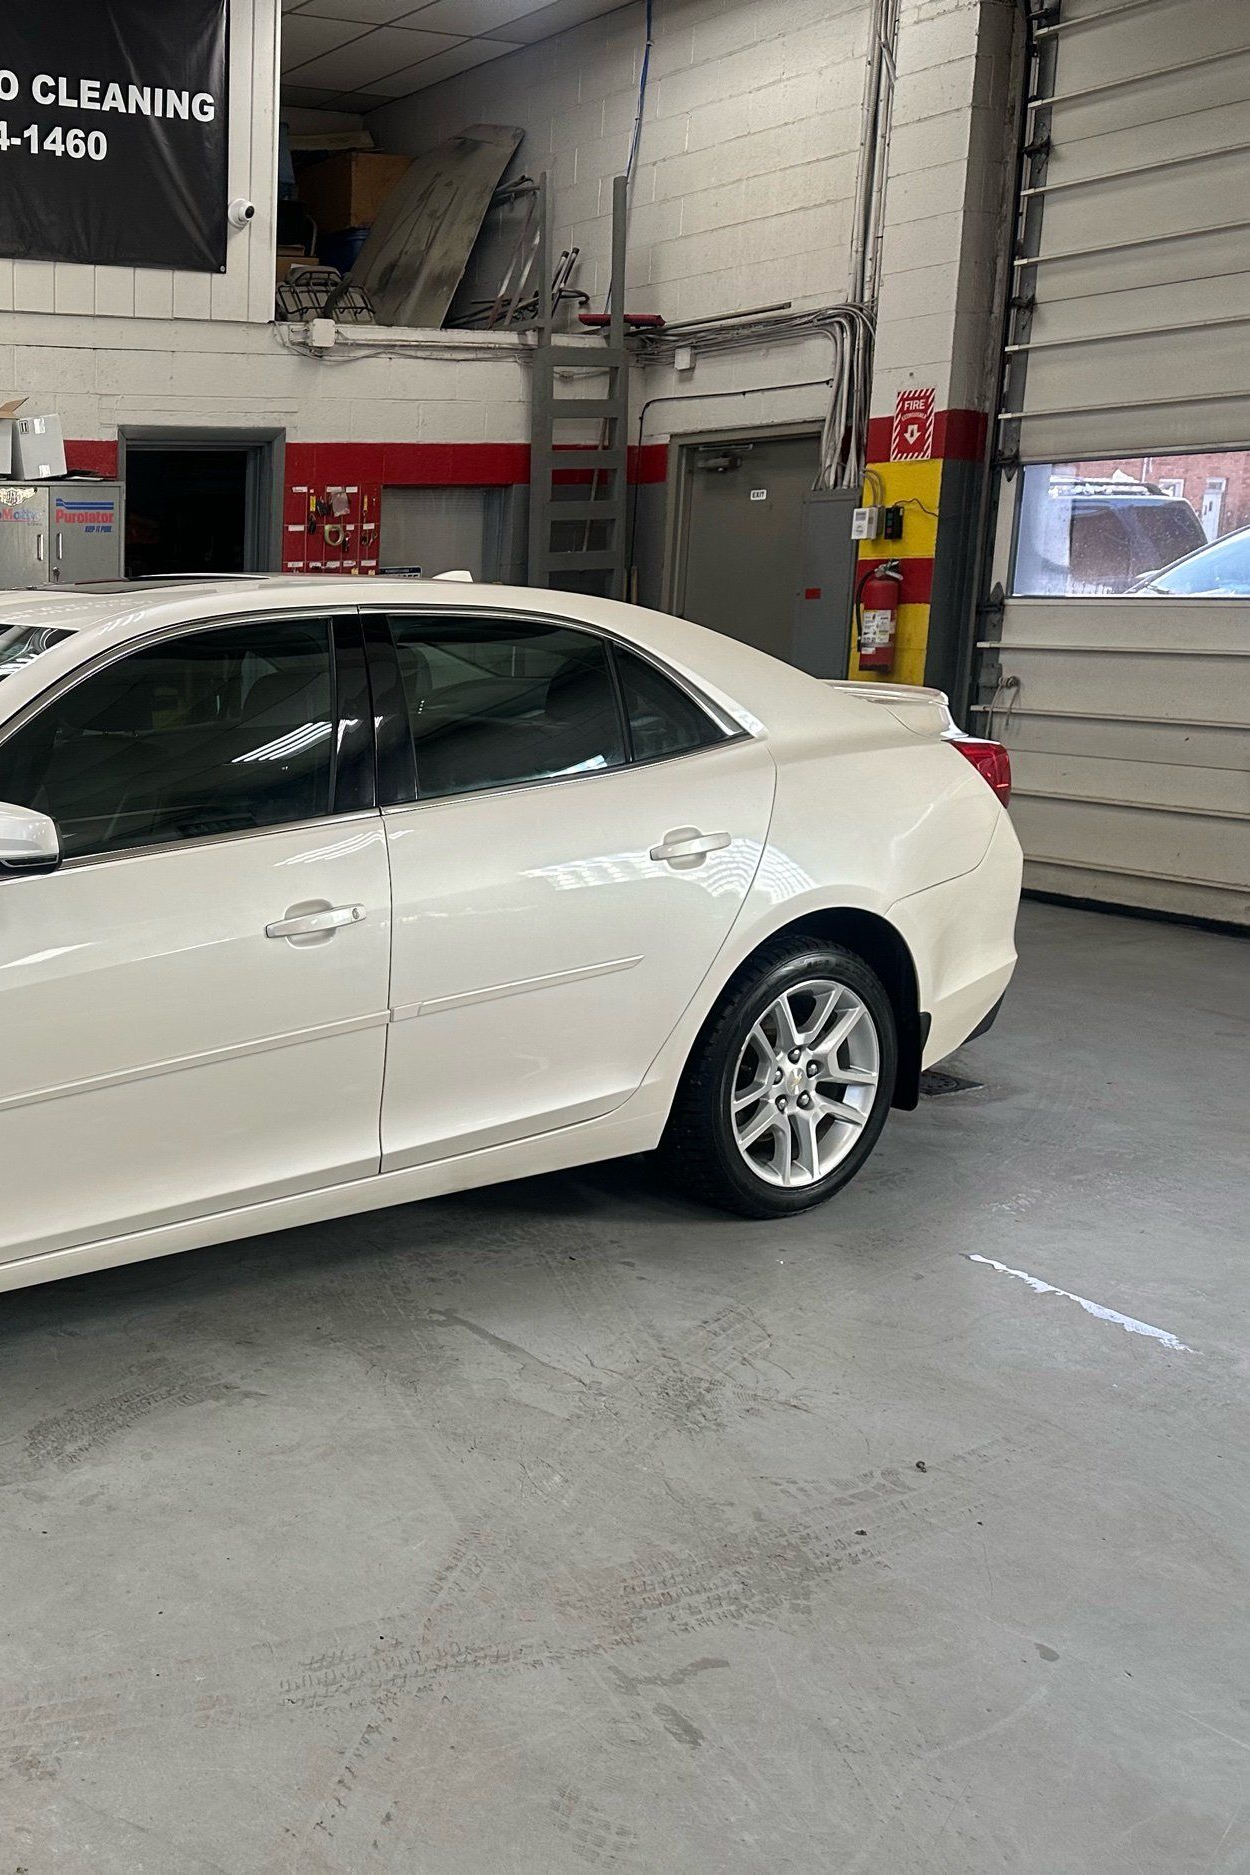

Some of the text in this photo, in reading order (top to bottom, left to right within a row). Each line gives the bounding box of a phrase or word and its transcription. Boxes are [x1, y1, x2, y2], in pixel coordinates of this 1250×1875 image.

[32, 74, 214, 122] CLEANING
[904, 399, 925, 411] FIRE
[751, 490, 766, 499] EXIT
[55, 509, 114, 524] Purolator
